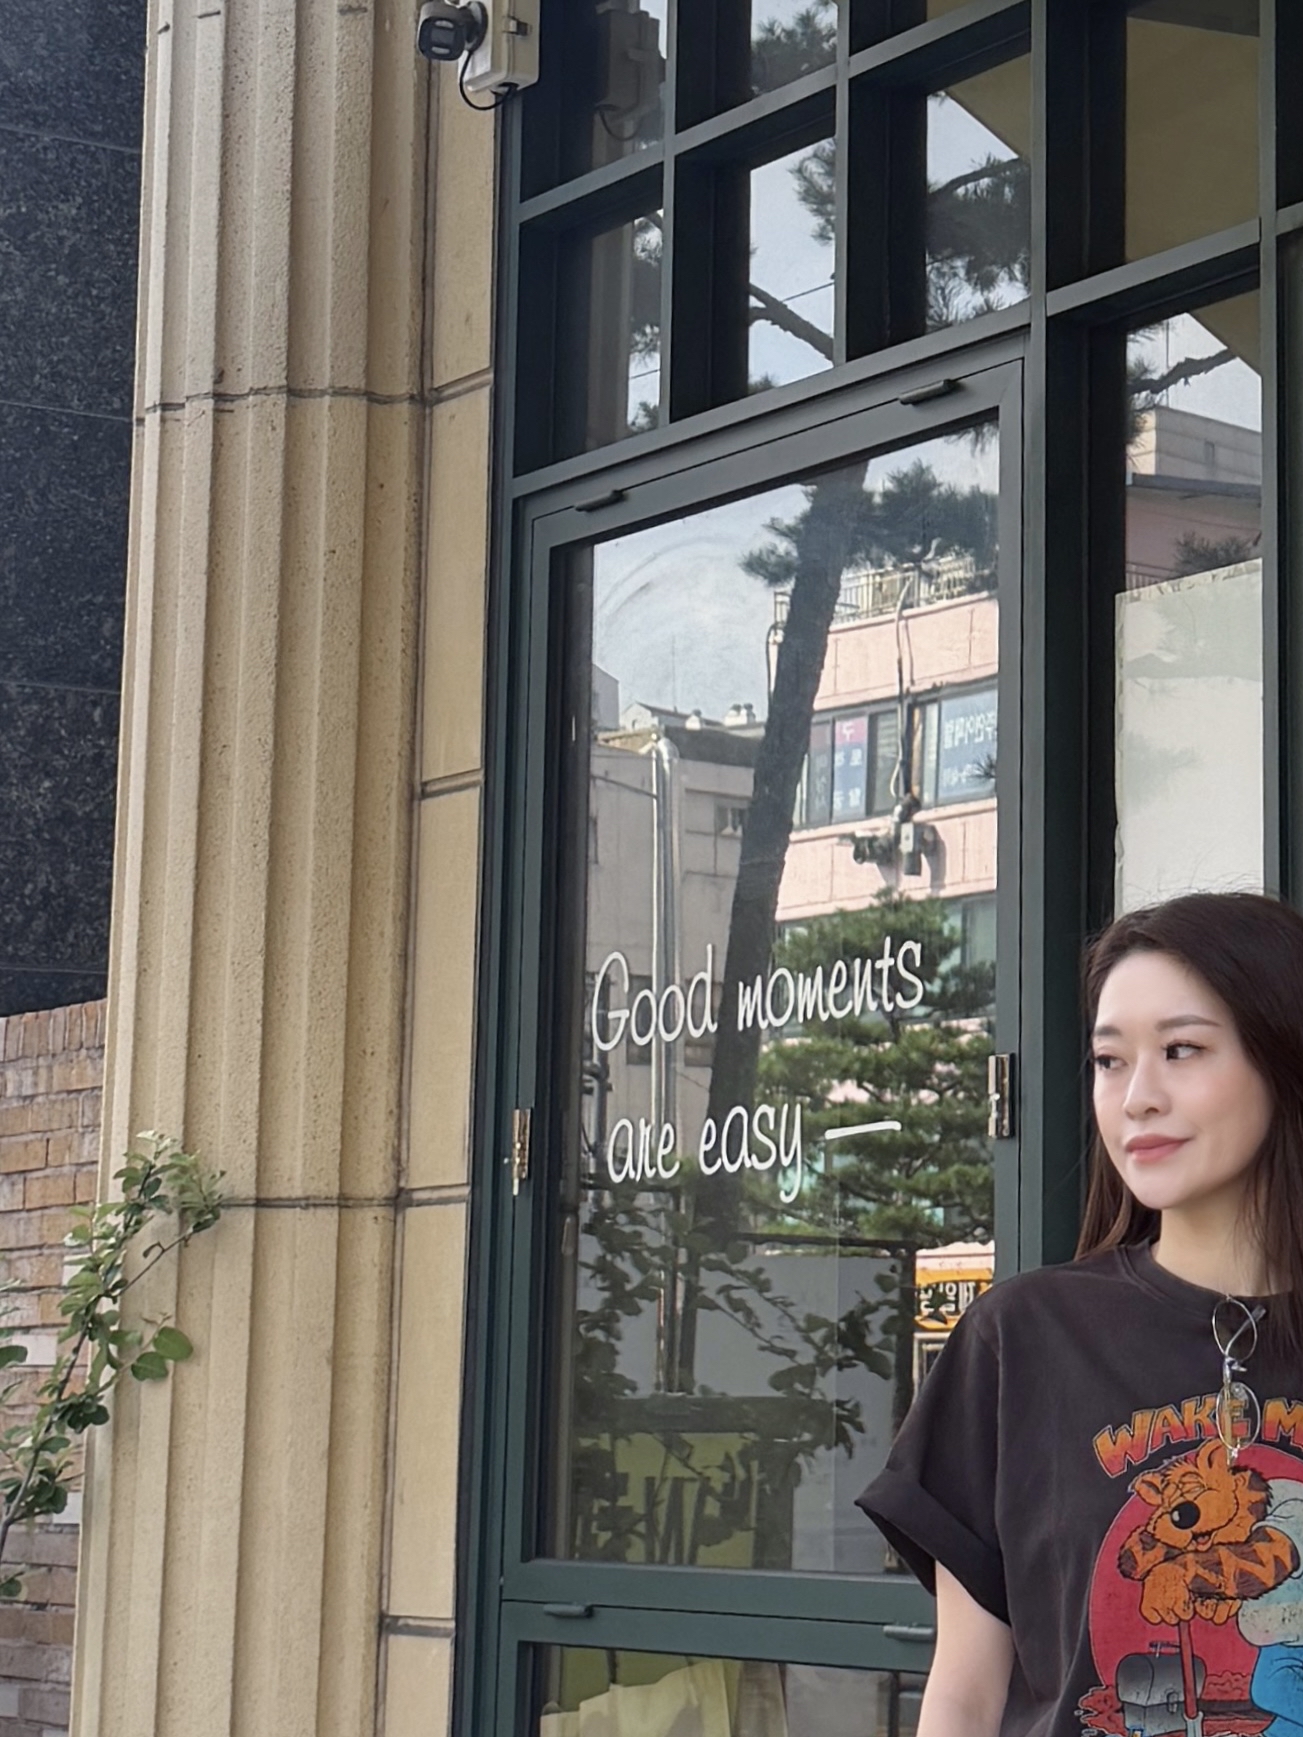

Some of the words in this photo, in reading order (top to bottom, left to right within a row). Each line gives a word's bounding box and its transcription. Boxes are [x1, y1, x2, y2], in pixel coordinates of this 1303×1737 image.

[592, 943, 717, 1051] Good
[737, 936, 924, 1032] moments
[606, 1115, 679, 1183] are
[698, 1103, 803, 1203] easy
[1093, 1396, 1252, 1478] WAKE
